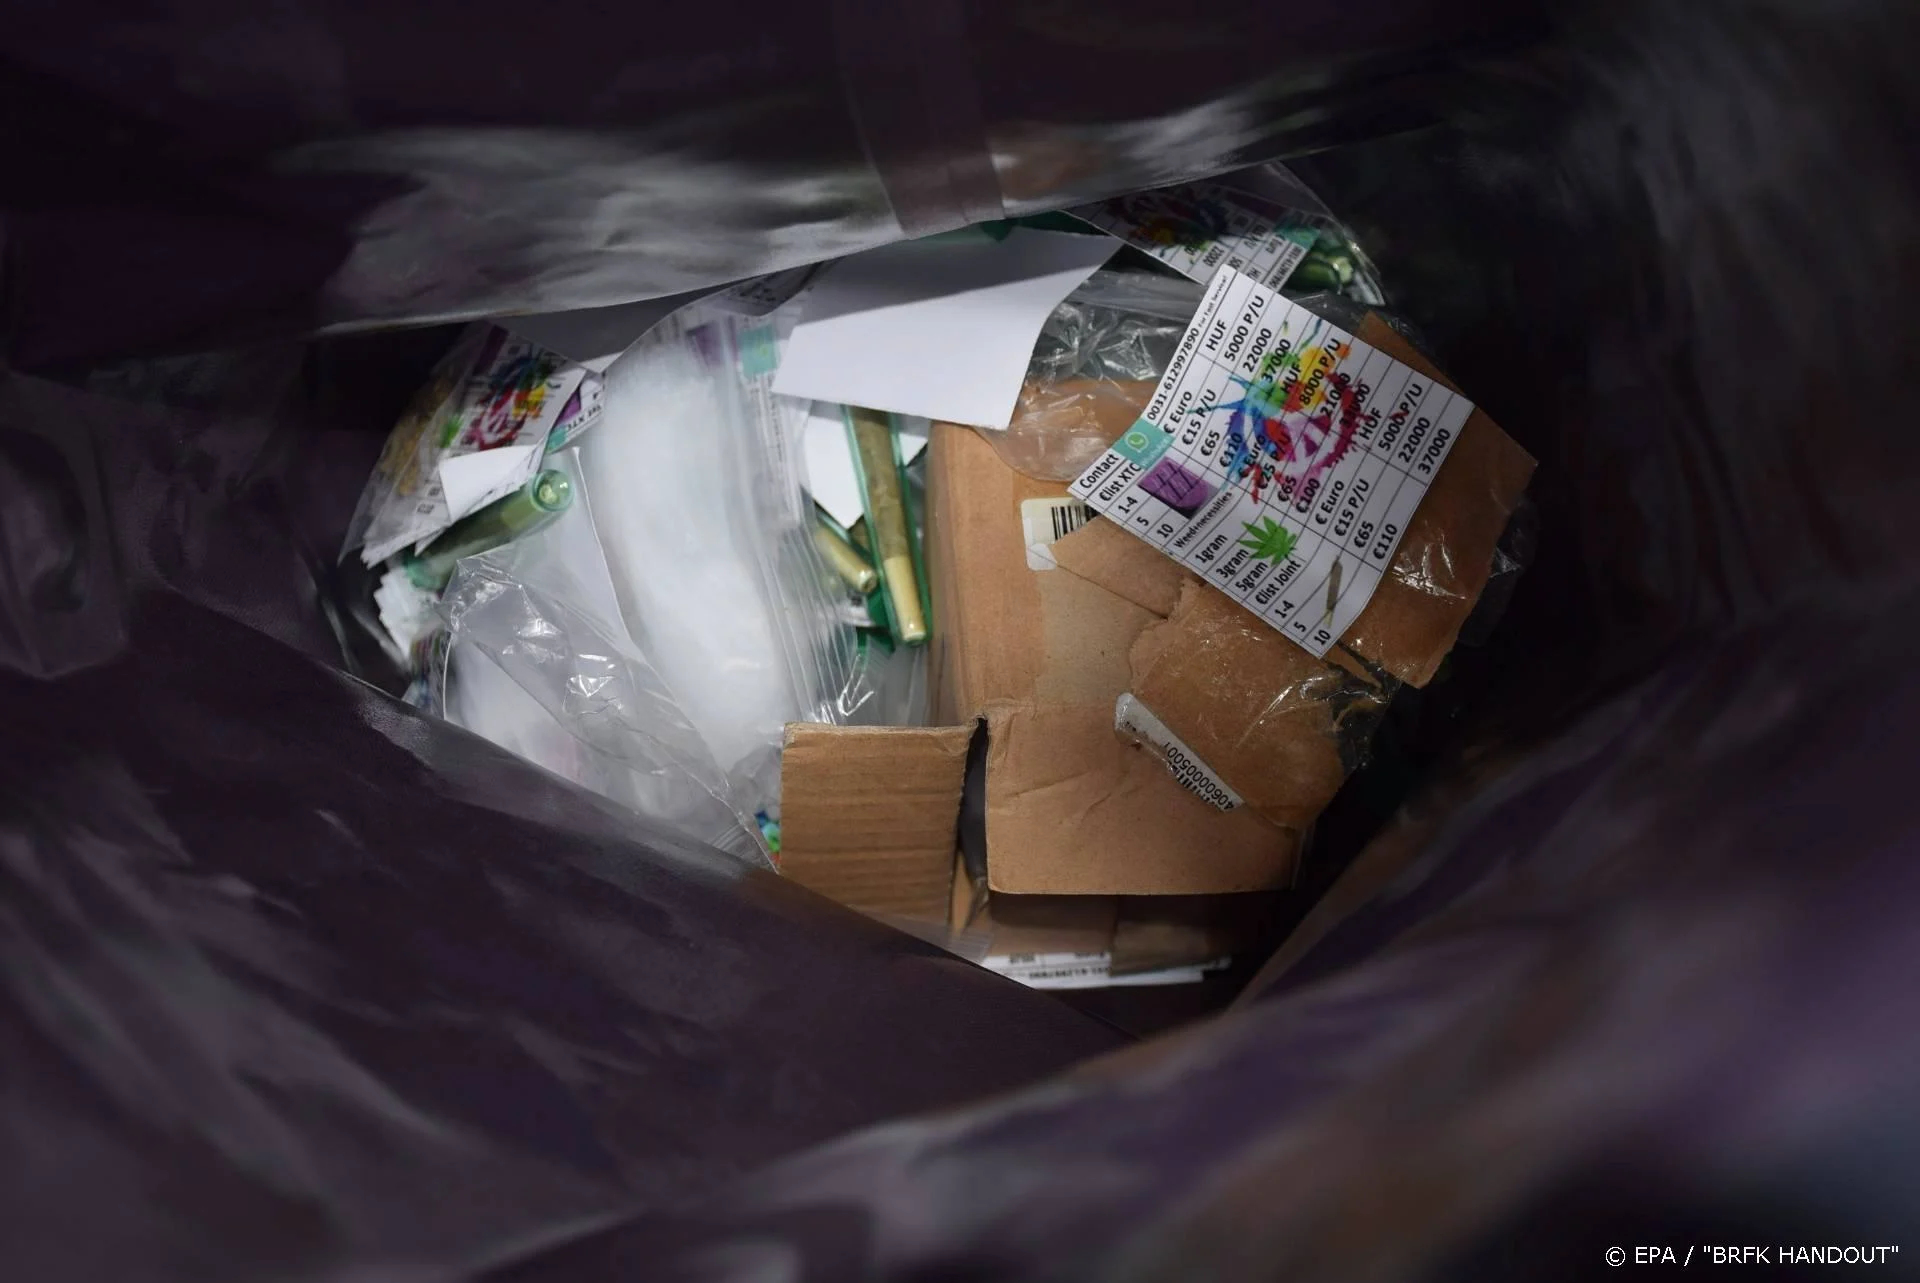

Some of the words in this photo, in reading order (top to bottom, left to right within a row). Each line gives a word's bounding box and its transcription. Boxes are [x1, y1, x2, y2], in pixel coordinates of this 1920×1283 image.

[1204, 318, 1227, 352] HUF
[1223, 324, 1249, 362] 5000
[1242, 294, 1265, 325] P/U
[1241, 327, 1272, 373] 22000
[1260, 338, 1292, 385] 37000
[1146, 326, 1200, 421] 0031-612997890
[1277, 359, 1301, 395] HUF
[1296, 367, 1328, 406] 8000
[1317, 337, 1343, 370] P/U
[1168, 390, 1193, 424] Euro
[1319, 371, 1352, 419] 21000
[1162, 423, 1176, 435] €
[1181, 418, 1202, 446] €15
[1192, 388, 1217, 419] P/U
[1357, 406, 1383, 441] HUF
[1377, 411, 1406, 452] 5000
[1398, 382, 1423, 416] P/U
[1199, 429, 1221, 457] €65
[1218, 428, 1245, 468] €110
[1241, 431, 1268, 469] Euro
[1397, 416, 1431, 464] 22000
[1417, 427, 1451, 475] 37000
[1078, 453, 1120, 489] Contact
[1117, 461, 1143, 483] XTC
[1253, 462, 1276, 490] €25
[1117, 495, 1139, 515] 1-4
[1276, 474, 1298, 503] €65
[1294, 476, 1321, 514] €100
[1319, 479, 1345, 514] Euro
[1135, 515, 1150, 527] 5
[1314, 512, 1328, 525] €
[1333, 508, 1355, 537] €15
[1347, 477, 1370, 509] P/U
[1155, 522, 1174, 539] 10
[1352, 520, 1375, 549] €65
[1372, 522, 1398, 560] €110
[1194, 533, 1228, 564] 1gram
[1214, 548, 1250, 579] 3gram
[1234, 561, 1269, 593] 5gram
[1272, 558, 1302, 587] Joint
[1273, 599, 1295, 619] 1-4
[1292, 620, 1307, 633] 5
[1312, 628, 1332, 646] 10
